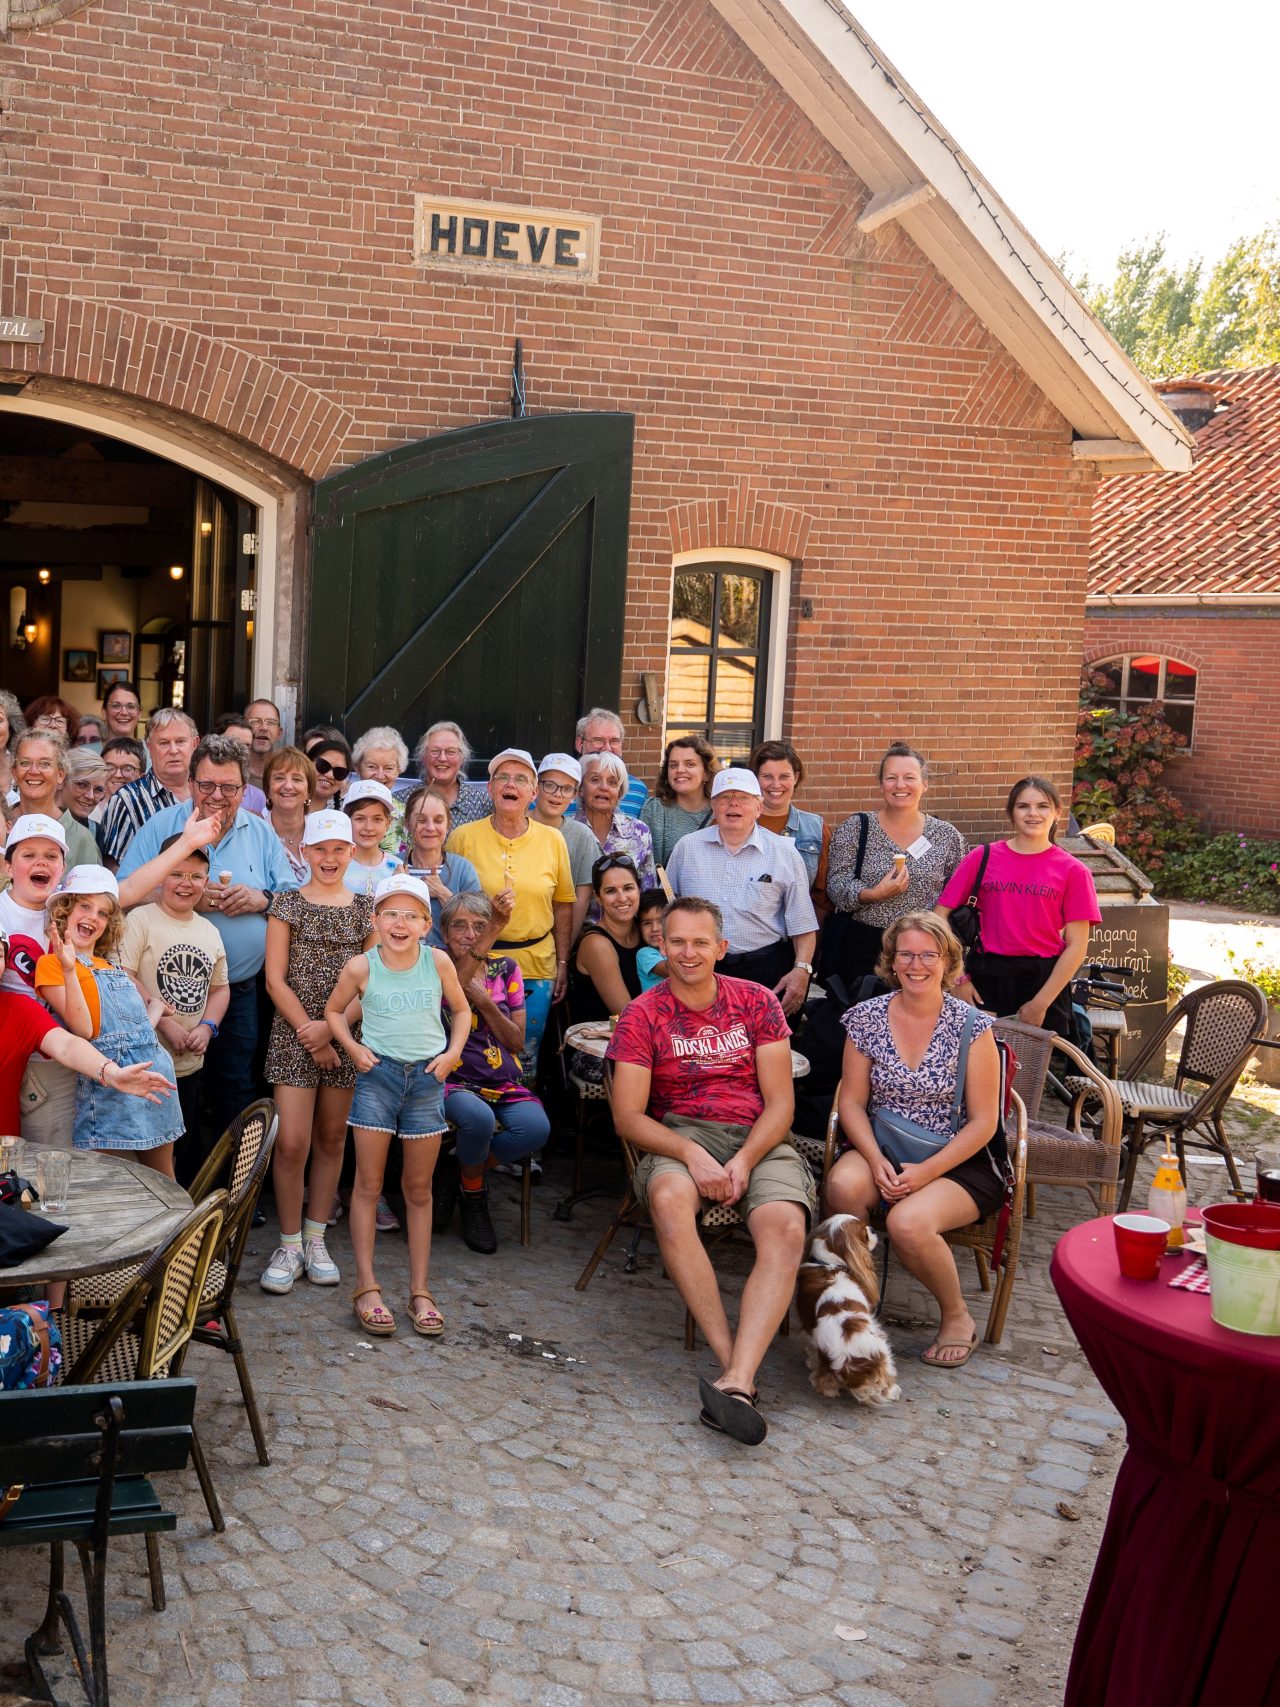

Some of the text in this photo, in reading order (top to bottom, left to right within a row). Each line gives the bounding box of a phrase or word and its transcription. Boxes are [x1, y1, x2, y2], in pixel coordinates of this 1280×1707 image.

[430, 214, 582, 268] HOEVE
[983, 880, 1059, 901] CALVIN KLEIN
[374, 989, 433, 1016] LOVE
[674, 1029, 750, 1057] DOCKLANDS
